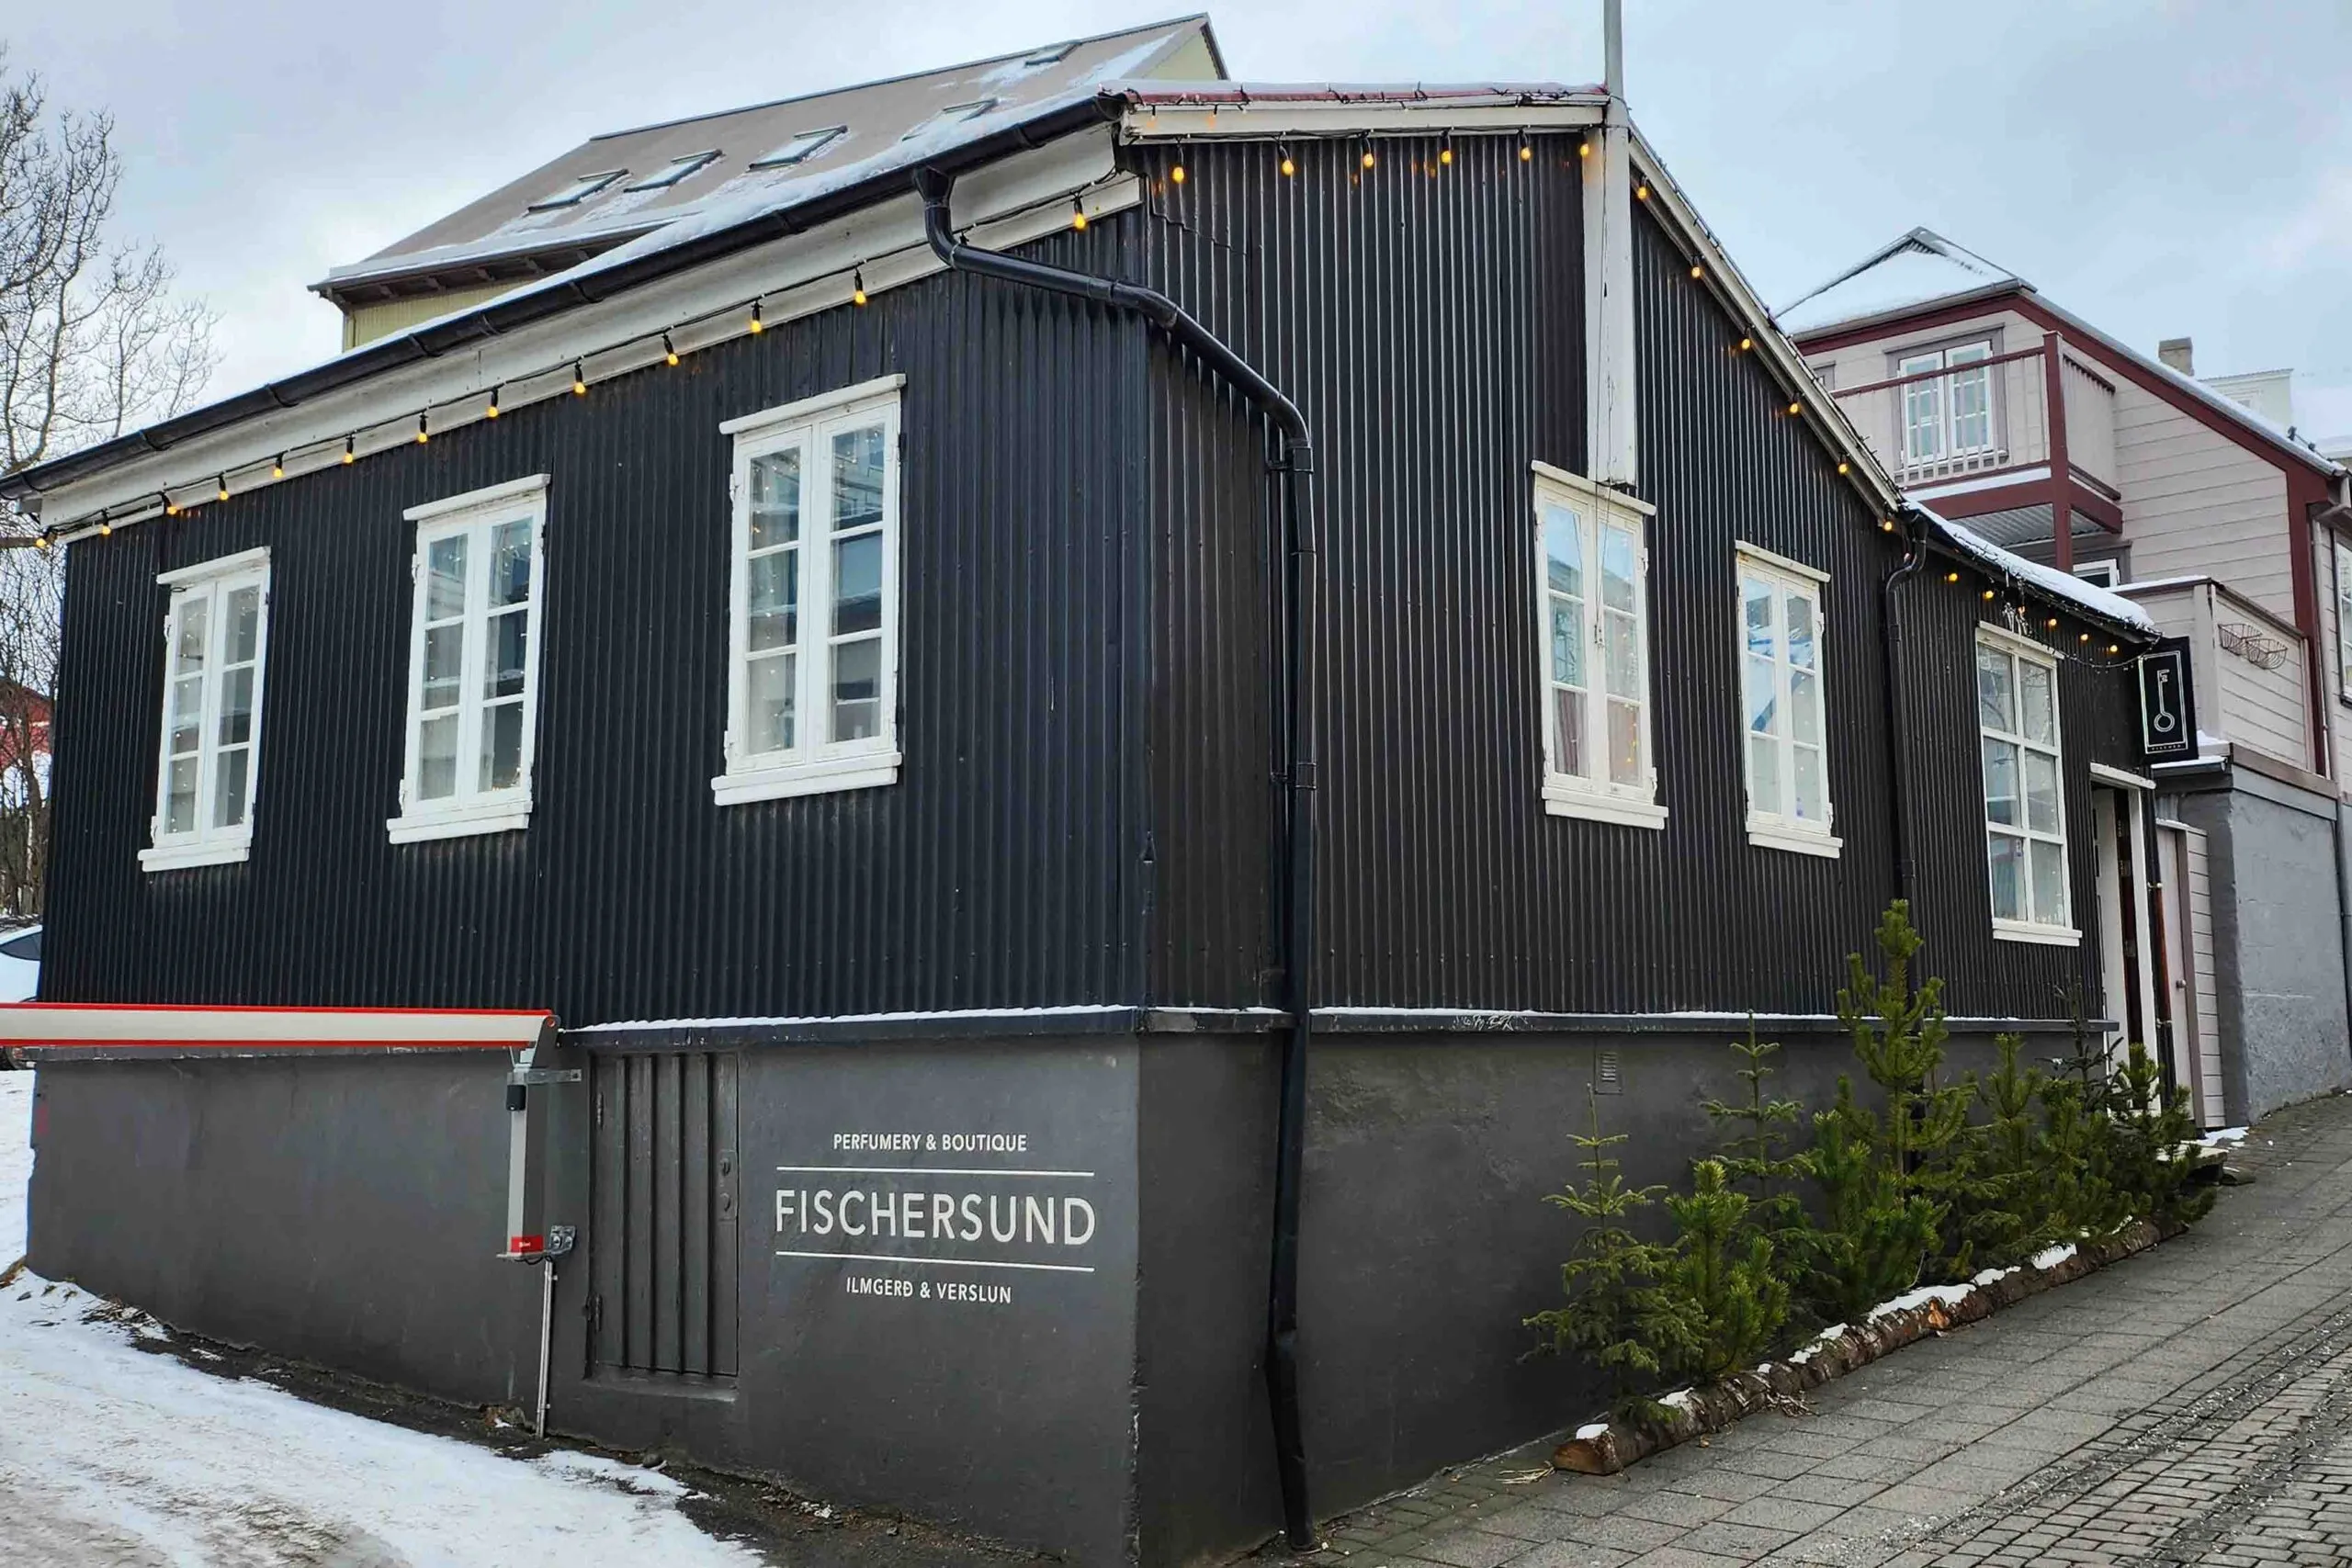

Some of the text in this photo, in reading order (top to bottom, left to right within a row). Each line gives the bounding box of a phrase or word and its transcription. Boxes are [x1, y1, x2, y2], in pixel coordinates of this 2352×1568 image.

[833, 1134, 1027, 1153] PERFUMERY & BOUTIQUE
[775, 1189, 1096, 1246] FISCHERSUND
[846, 1277, 1012, 1304] ILMGERÐ & VERSLUN
